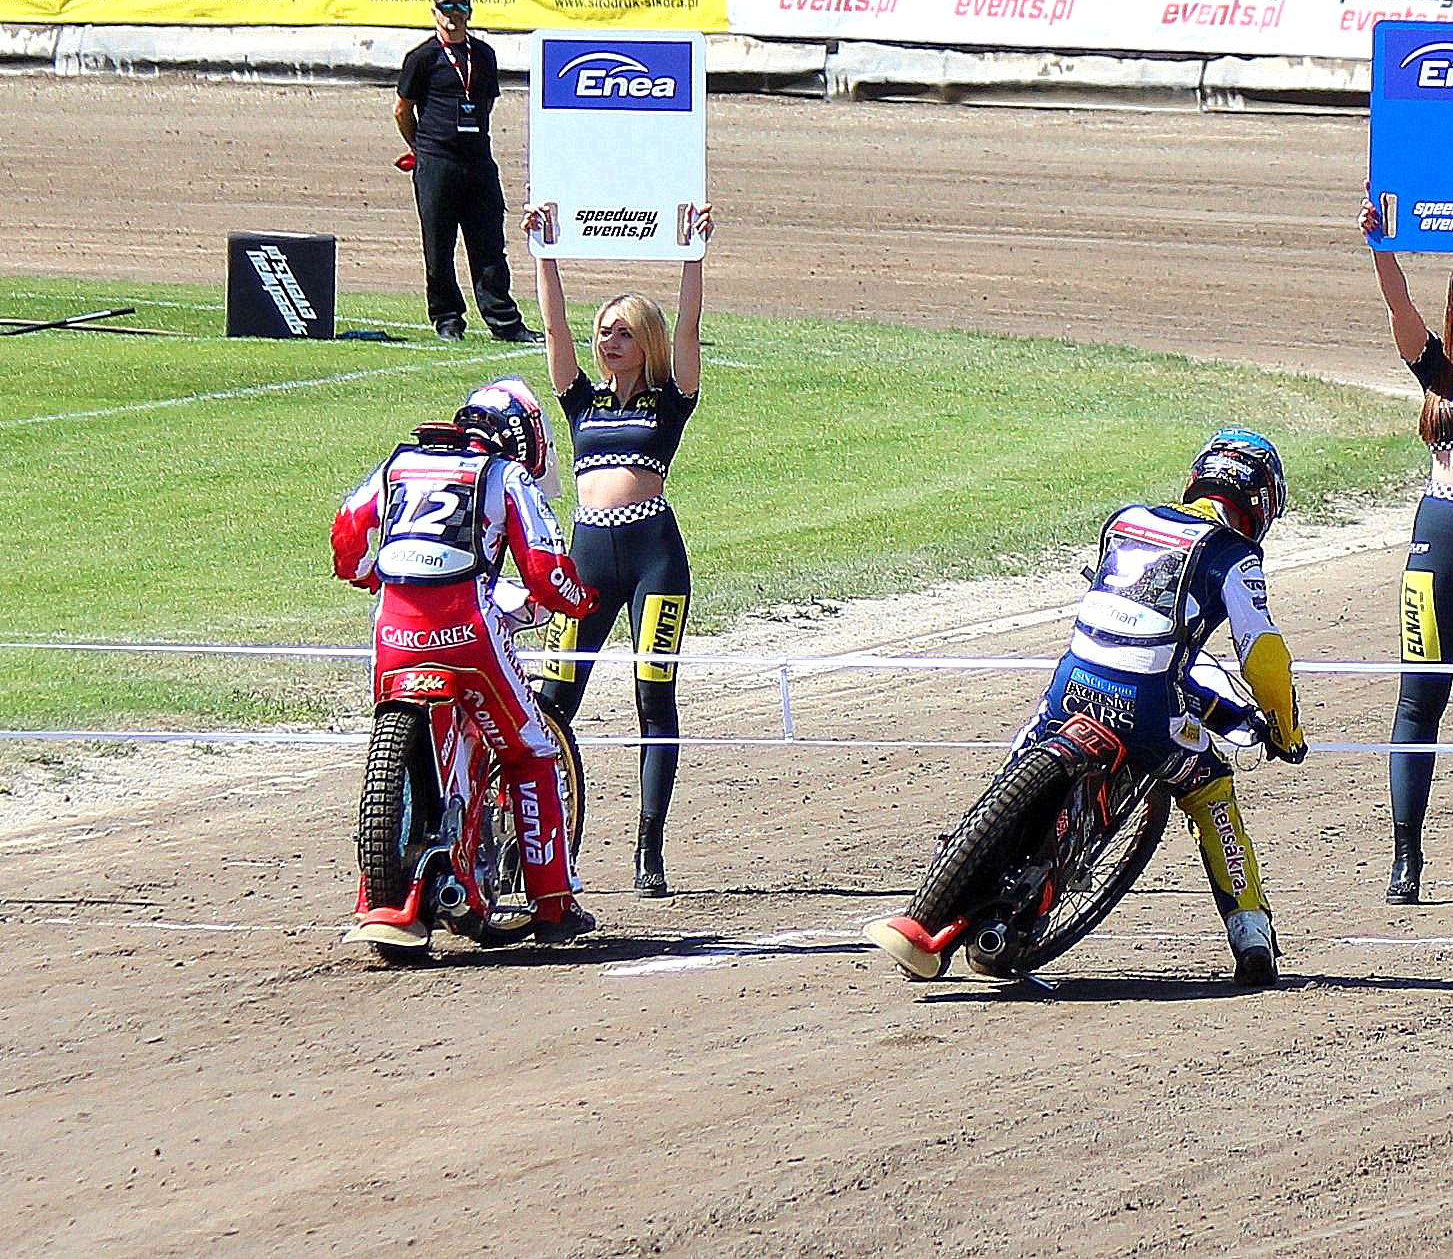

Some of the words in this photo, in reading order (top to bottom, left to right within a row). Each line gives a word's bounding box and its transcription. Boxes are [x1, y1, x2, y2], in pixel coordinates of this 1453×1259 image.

[576, 69, 676, 98] Enea
[575, 207, 658, 226] speedway
[583, 223, 658, 240] events.pl
[390, 489, 460, 538] 12
[1404, 583, 1425, 658] ELNAFT
[381, 622, 477, 649] GARCAREK
